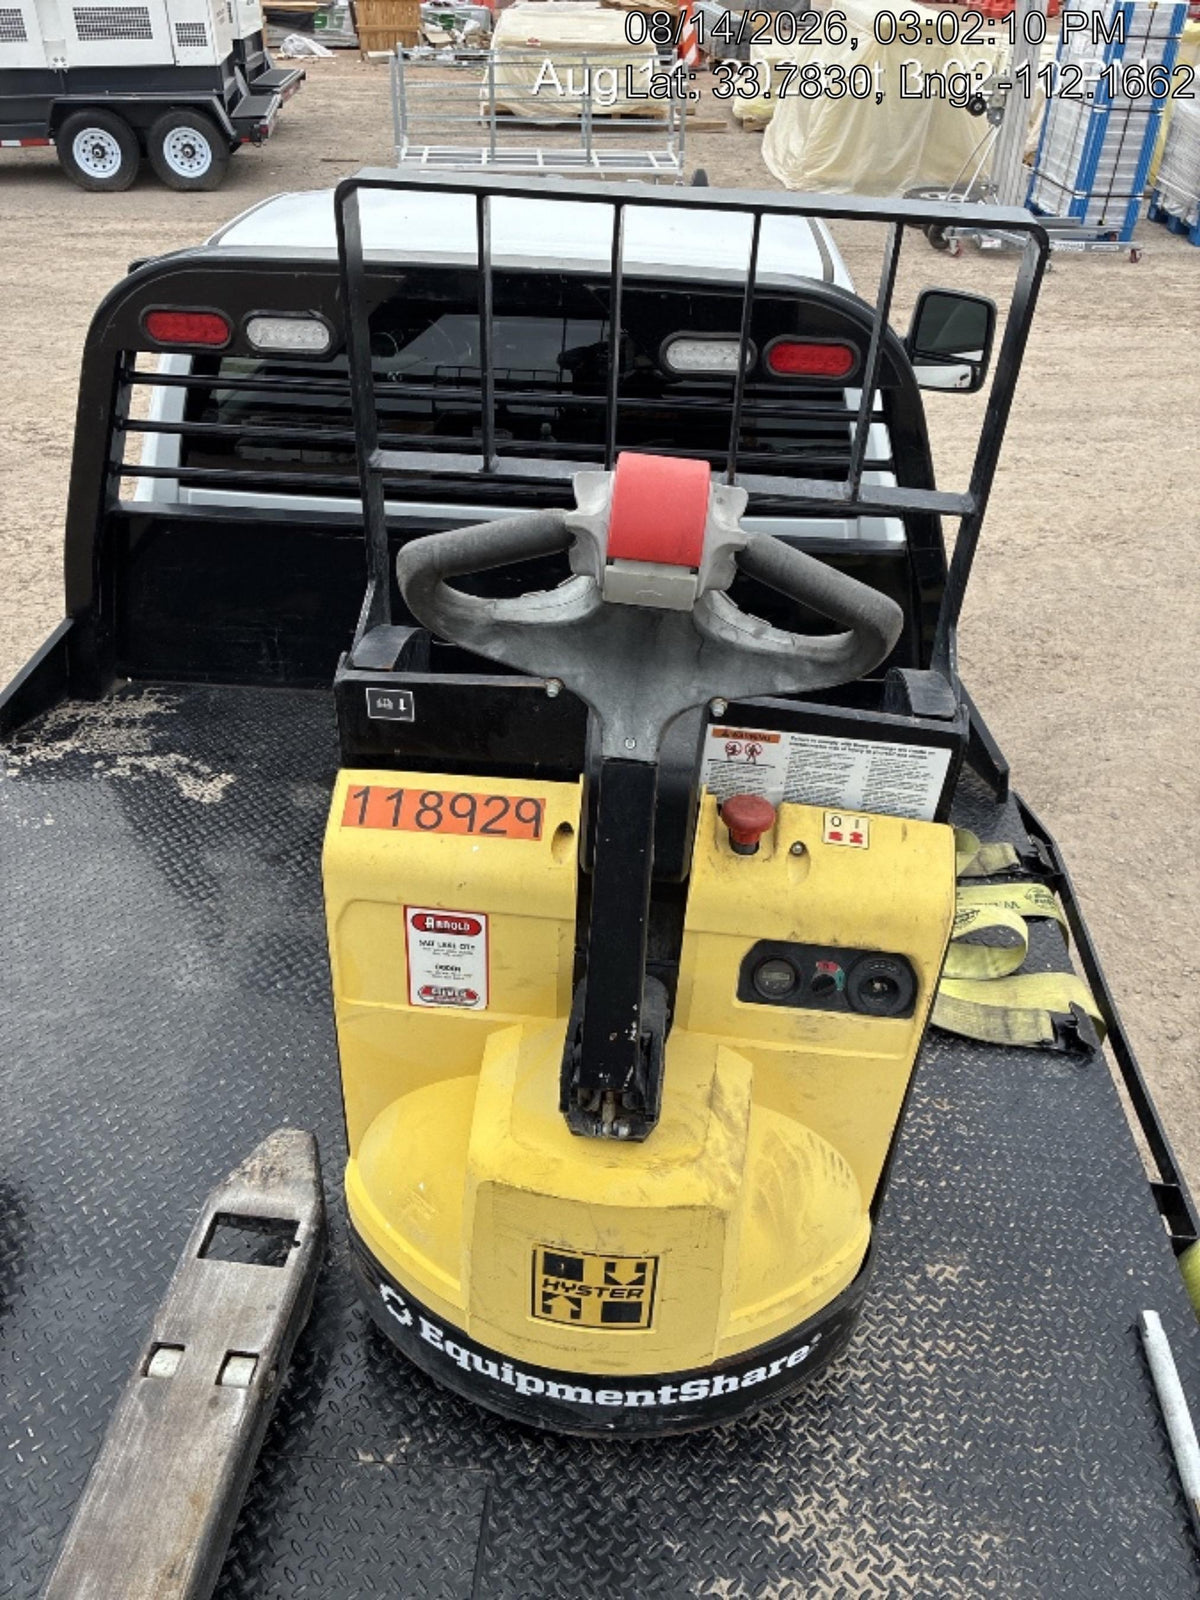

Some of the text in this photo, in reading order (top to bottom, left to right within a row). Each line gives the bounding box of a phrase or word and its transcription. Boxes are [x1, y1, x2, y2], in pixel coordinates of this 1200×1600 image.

[353, 785, 542, 838] 118929
[542, 1277, 644, 1299] HYSTER
[416, 1316, 811, 1407] EquipmentShare
